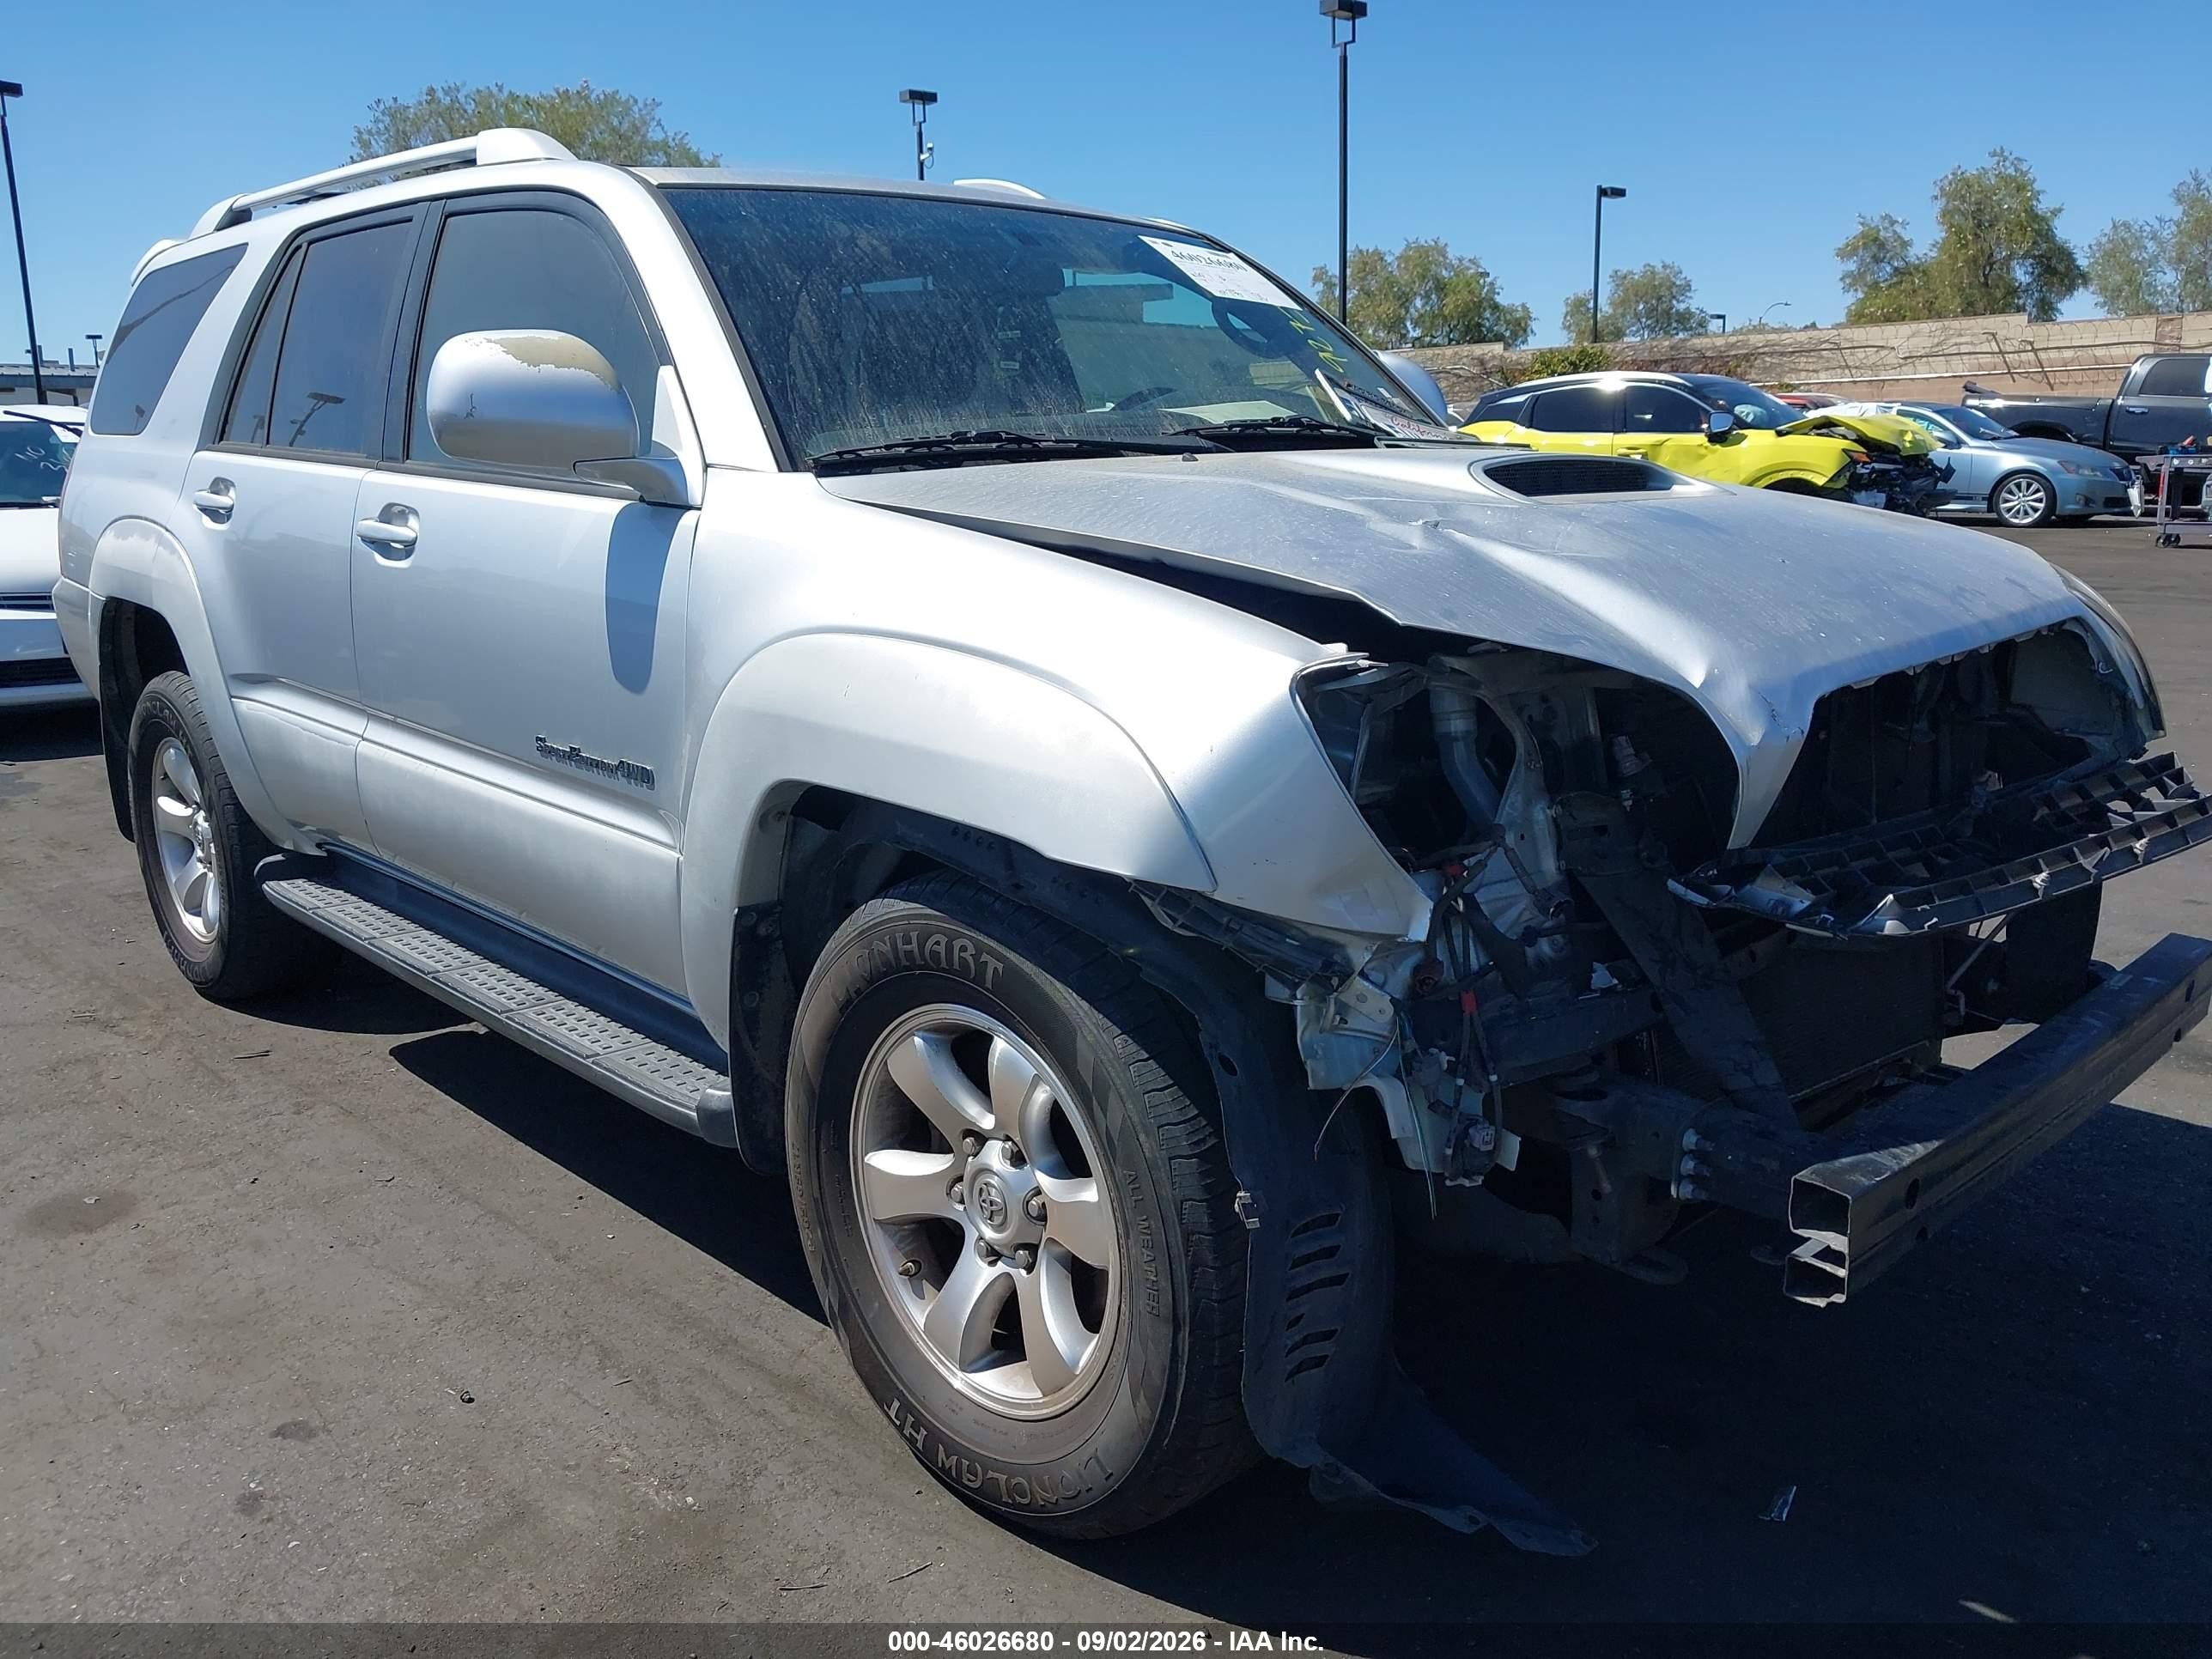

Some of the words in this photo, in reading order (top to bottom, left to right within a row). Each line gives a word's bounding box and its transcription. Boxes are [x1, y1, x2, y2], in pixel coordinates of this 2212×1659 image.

[1123, 1170, 1145, 1209] ALL
[1137, 1214, 1161, 1318] WEATHER
[883, 1397, 928, 1452] HT
[938, 1443, 1114, 1507] LIONCLAW
